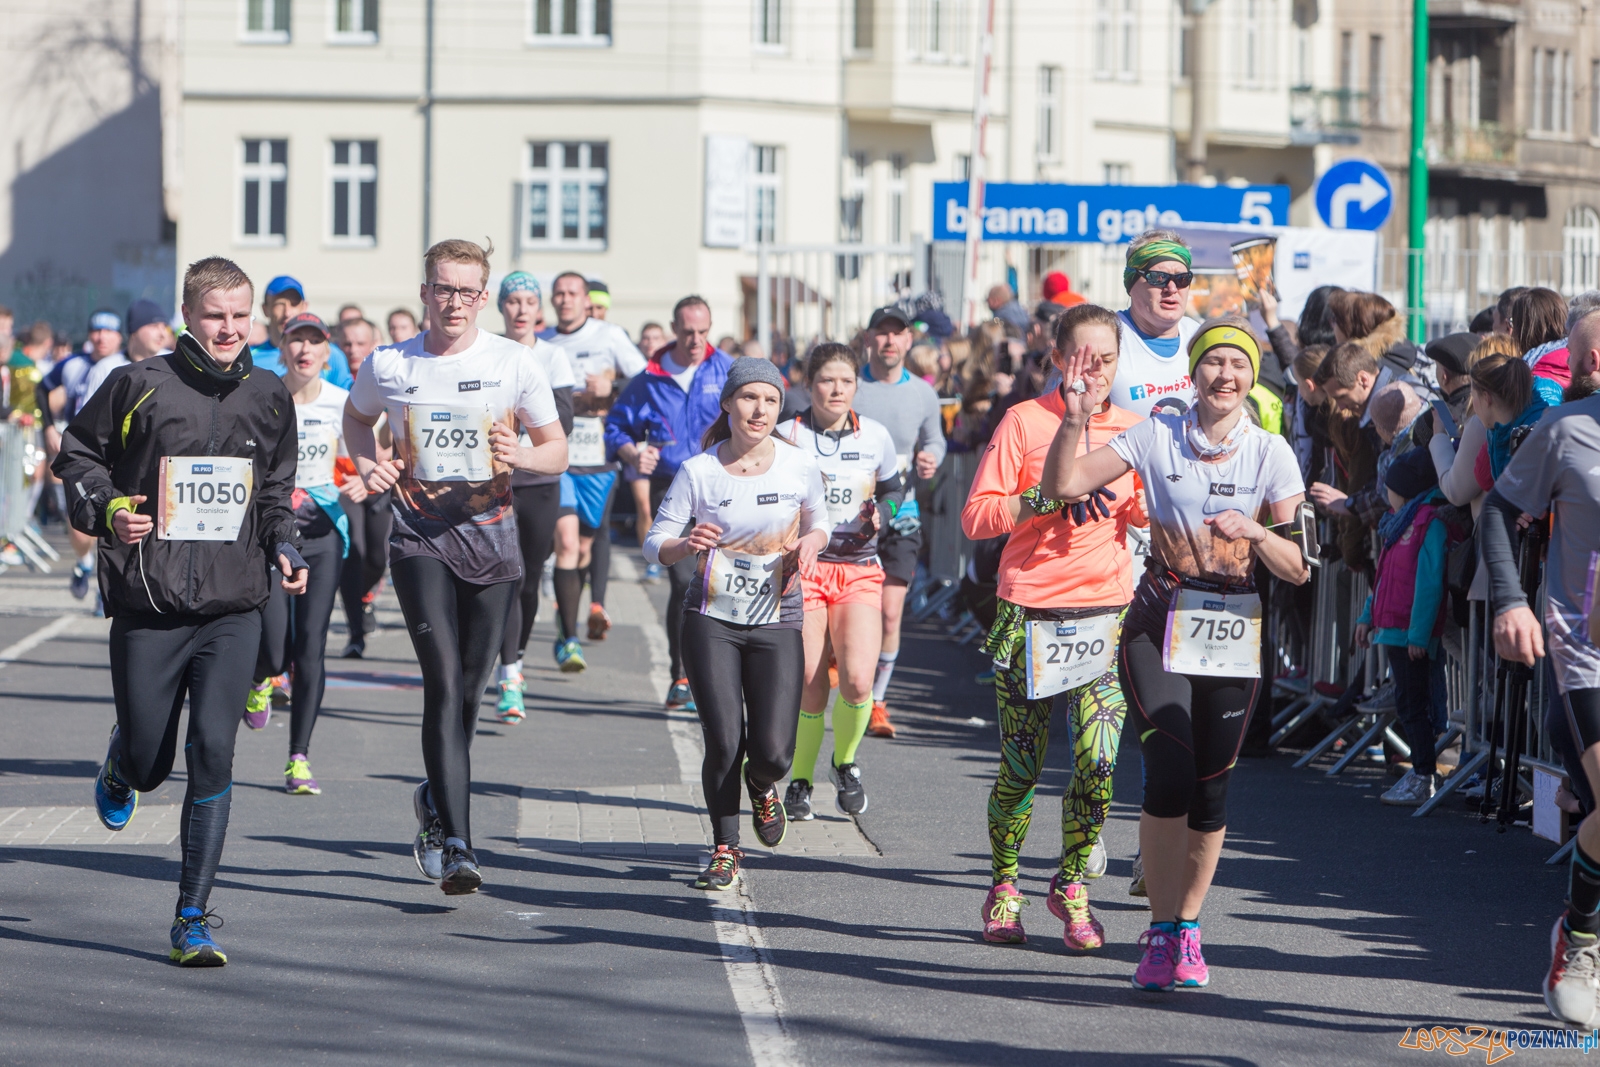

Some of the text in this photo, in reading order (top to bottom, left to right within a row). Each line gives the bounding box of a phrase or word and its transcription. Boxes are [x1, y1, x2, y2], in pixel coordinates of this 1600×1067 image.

[1239, 191, 1274, 226] 5
[421, 428, 479, 449] 7693
[174, 481, 247, 505] 11050
[724, 573, 771, 597] 1936
[1190, 616, 1246, 641] 7150
[1046, 638, 1105, 664] 2790
[1059, 660, 1092, 672] Magdalena
